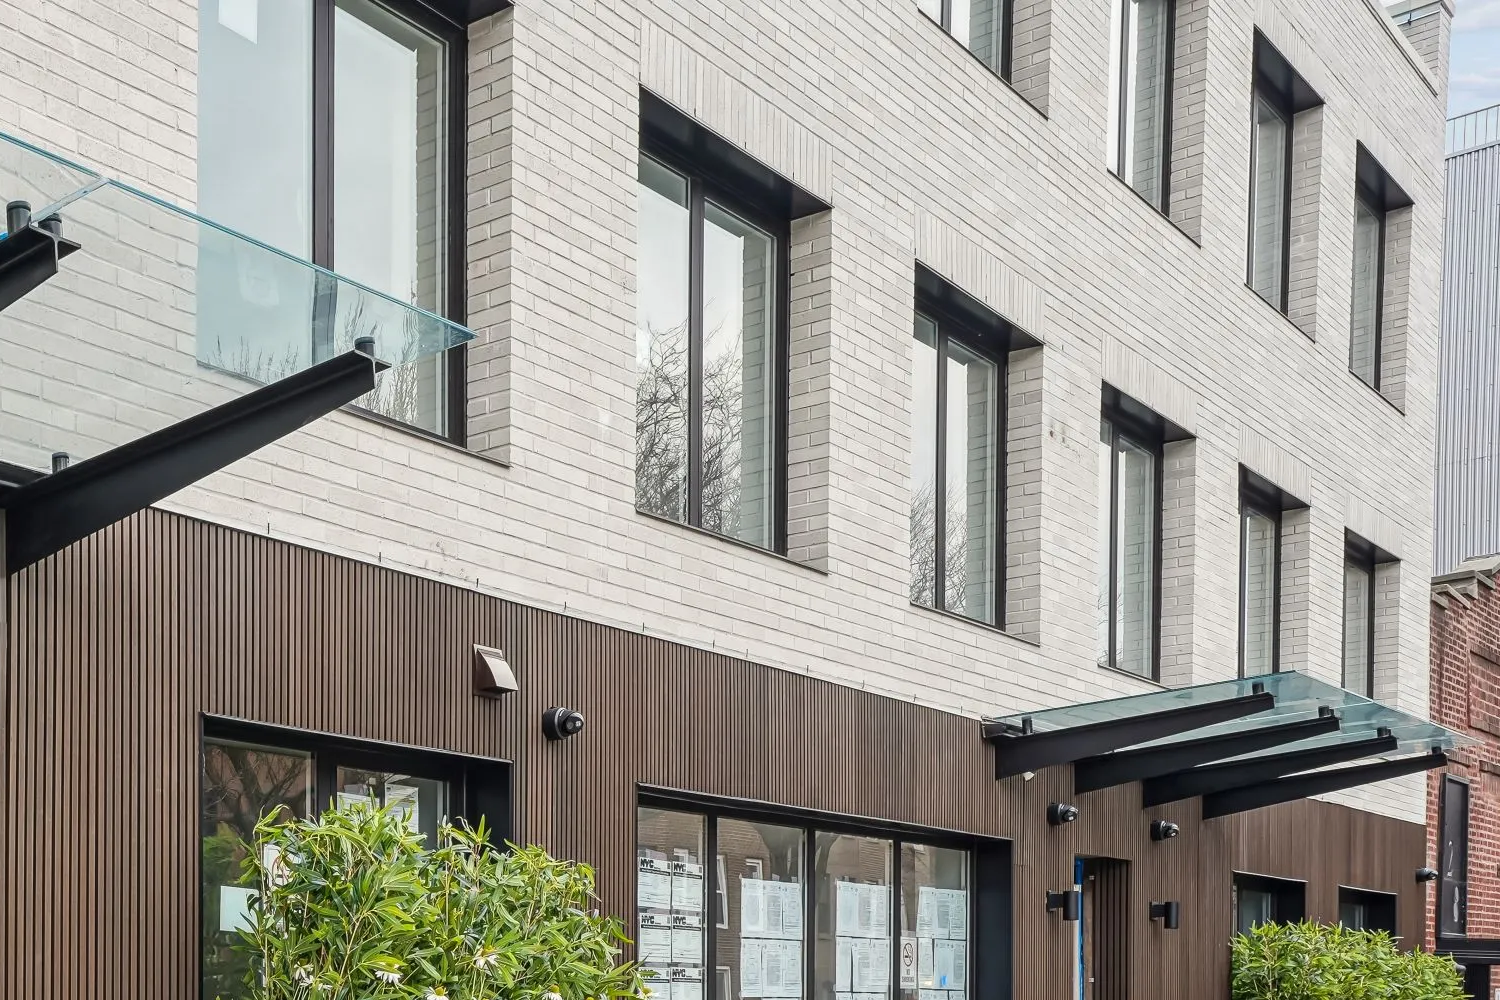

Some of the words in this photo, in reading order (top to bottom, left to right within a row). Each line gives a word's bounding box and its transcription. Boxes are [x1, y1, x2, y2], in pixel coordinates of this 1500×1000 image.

[640, 858, 654, 869] NYC
[673, 862, 687, 873] NYC
[641, 914, 655, 924] NYC
[673, 915, 687, 925] NYC
[672, 968, 686, 978] NYC
